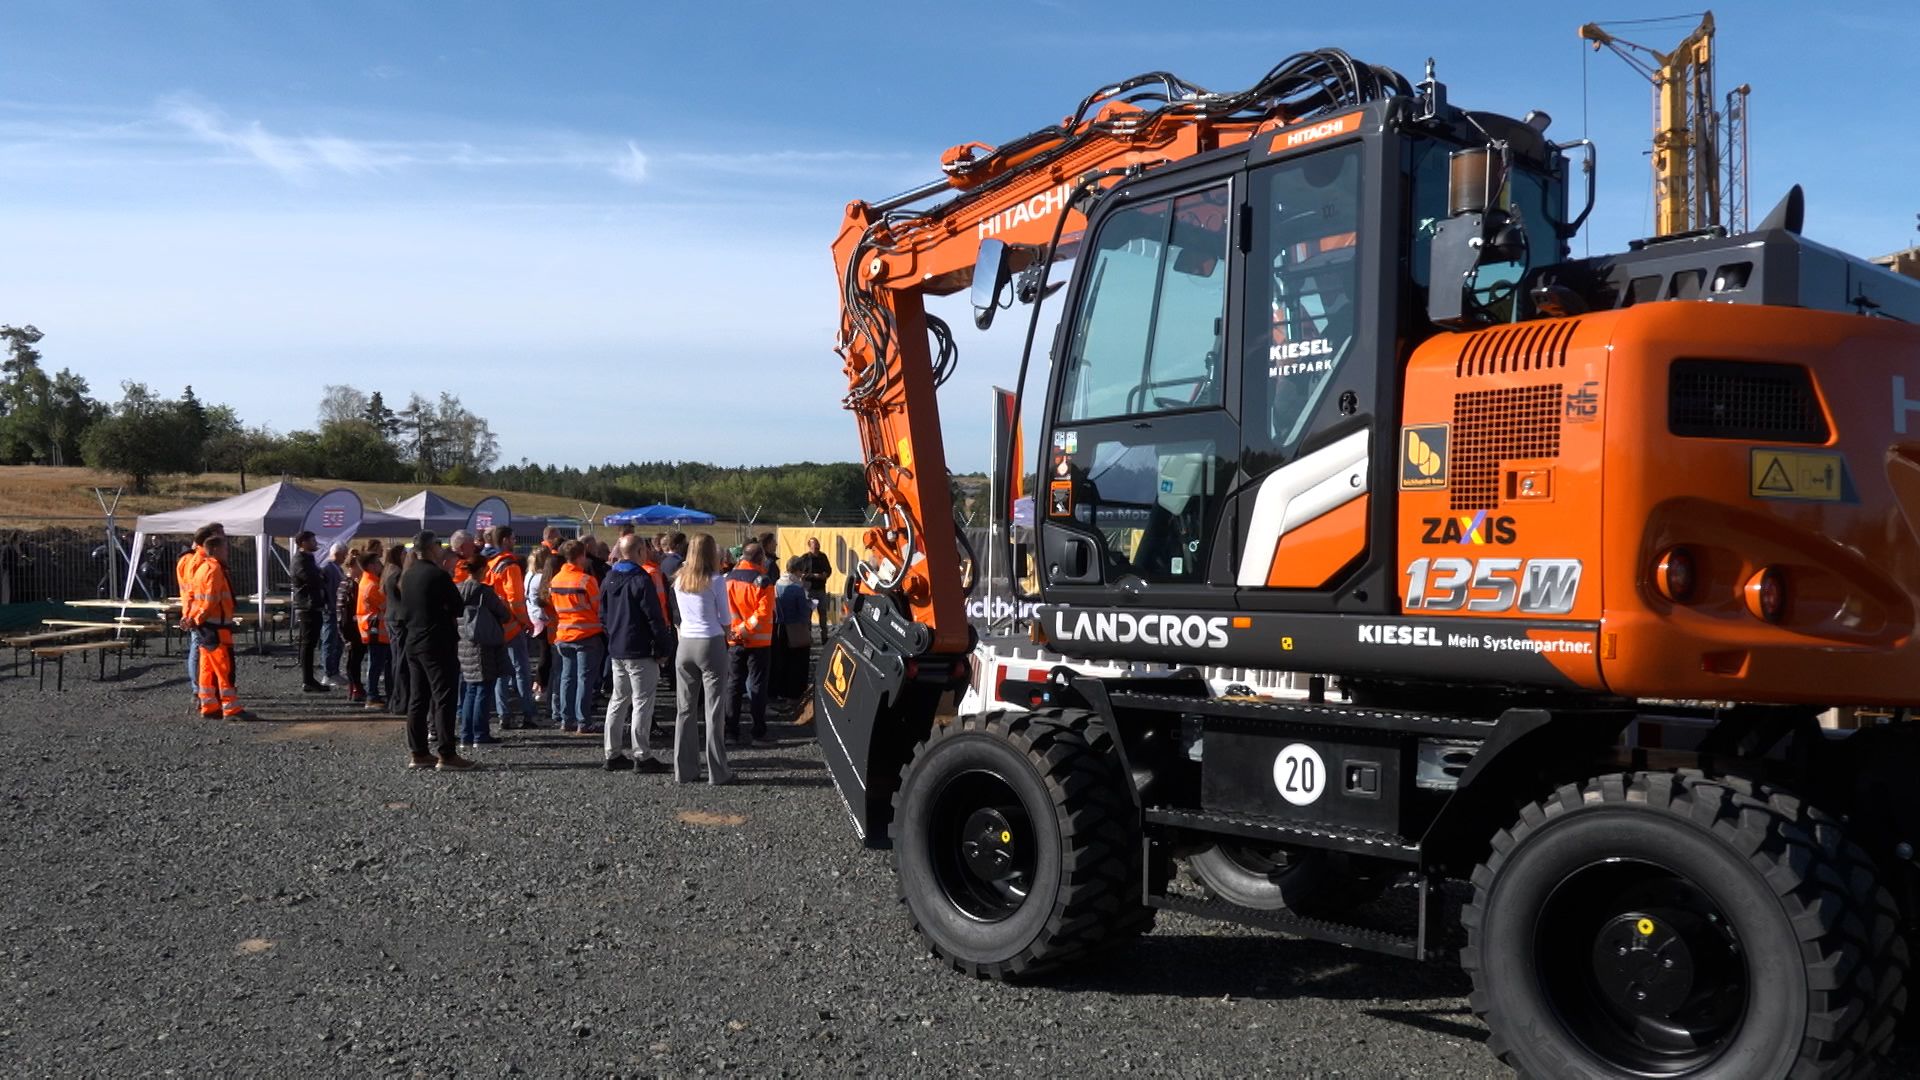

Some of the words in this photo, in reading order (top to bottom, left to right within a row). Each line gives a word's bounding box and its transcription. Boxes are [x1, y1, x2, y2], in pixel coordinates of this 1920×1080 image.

[1287, 119, 1344, 146] HITACHI
[978, 183, 1071, 240] HITACHI
[1269, 338, 1333, 361] KIESEL
[1268, 359, 1332, 378] MIETPARK
[1421, 509, 1517, 545] ZAXIS
[1405, 557, 1583, 615] 135W
[1055, 610, 1229, 649] LANDCROS
[1357, 623, 1443, 647] KIESEL
[1447, 633, 1480, 649] Mein
[1483, 634, 1593, 654] Systempartner.
[1285, 755, 1315, 794] 20
